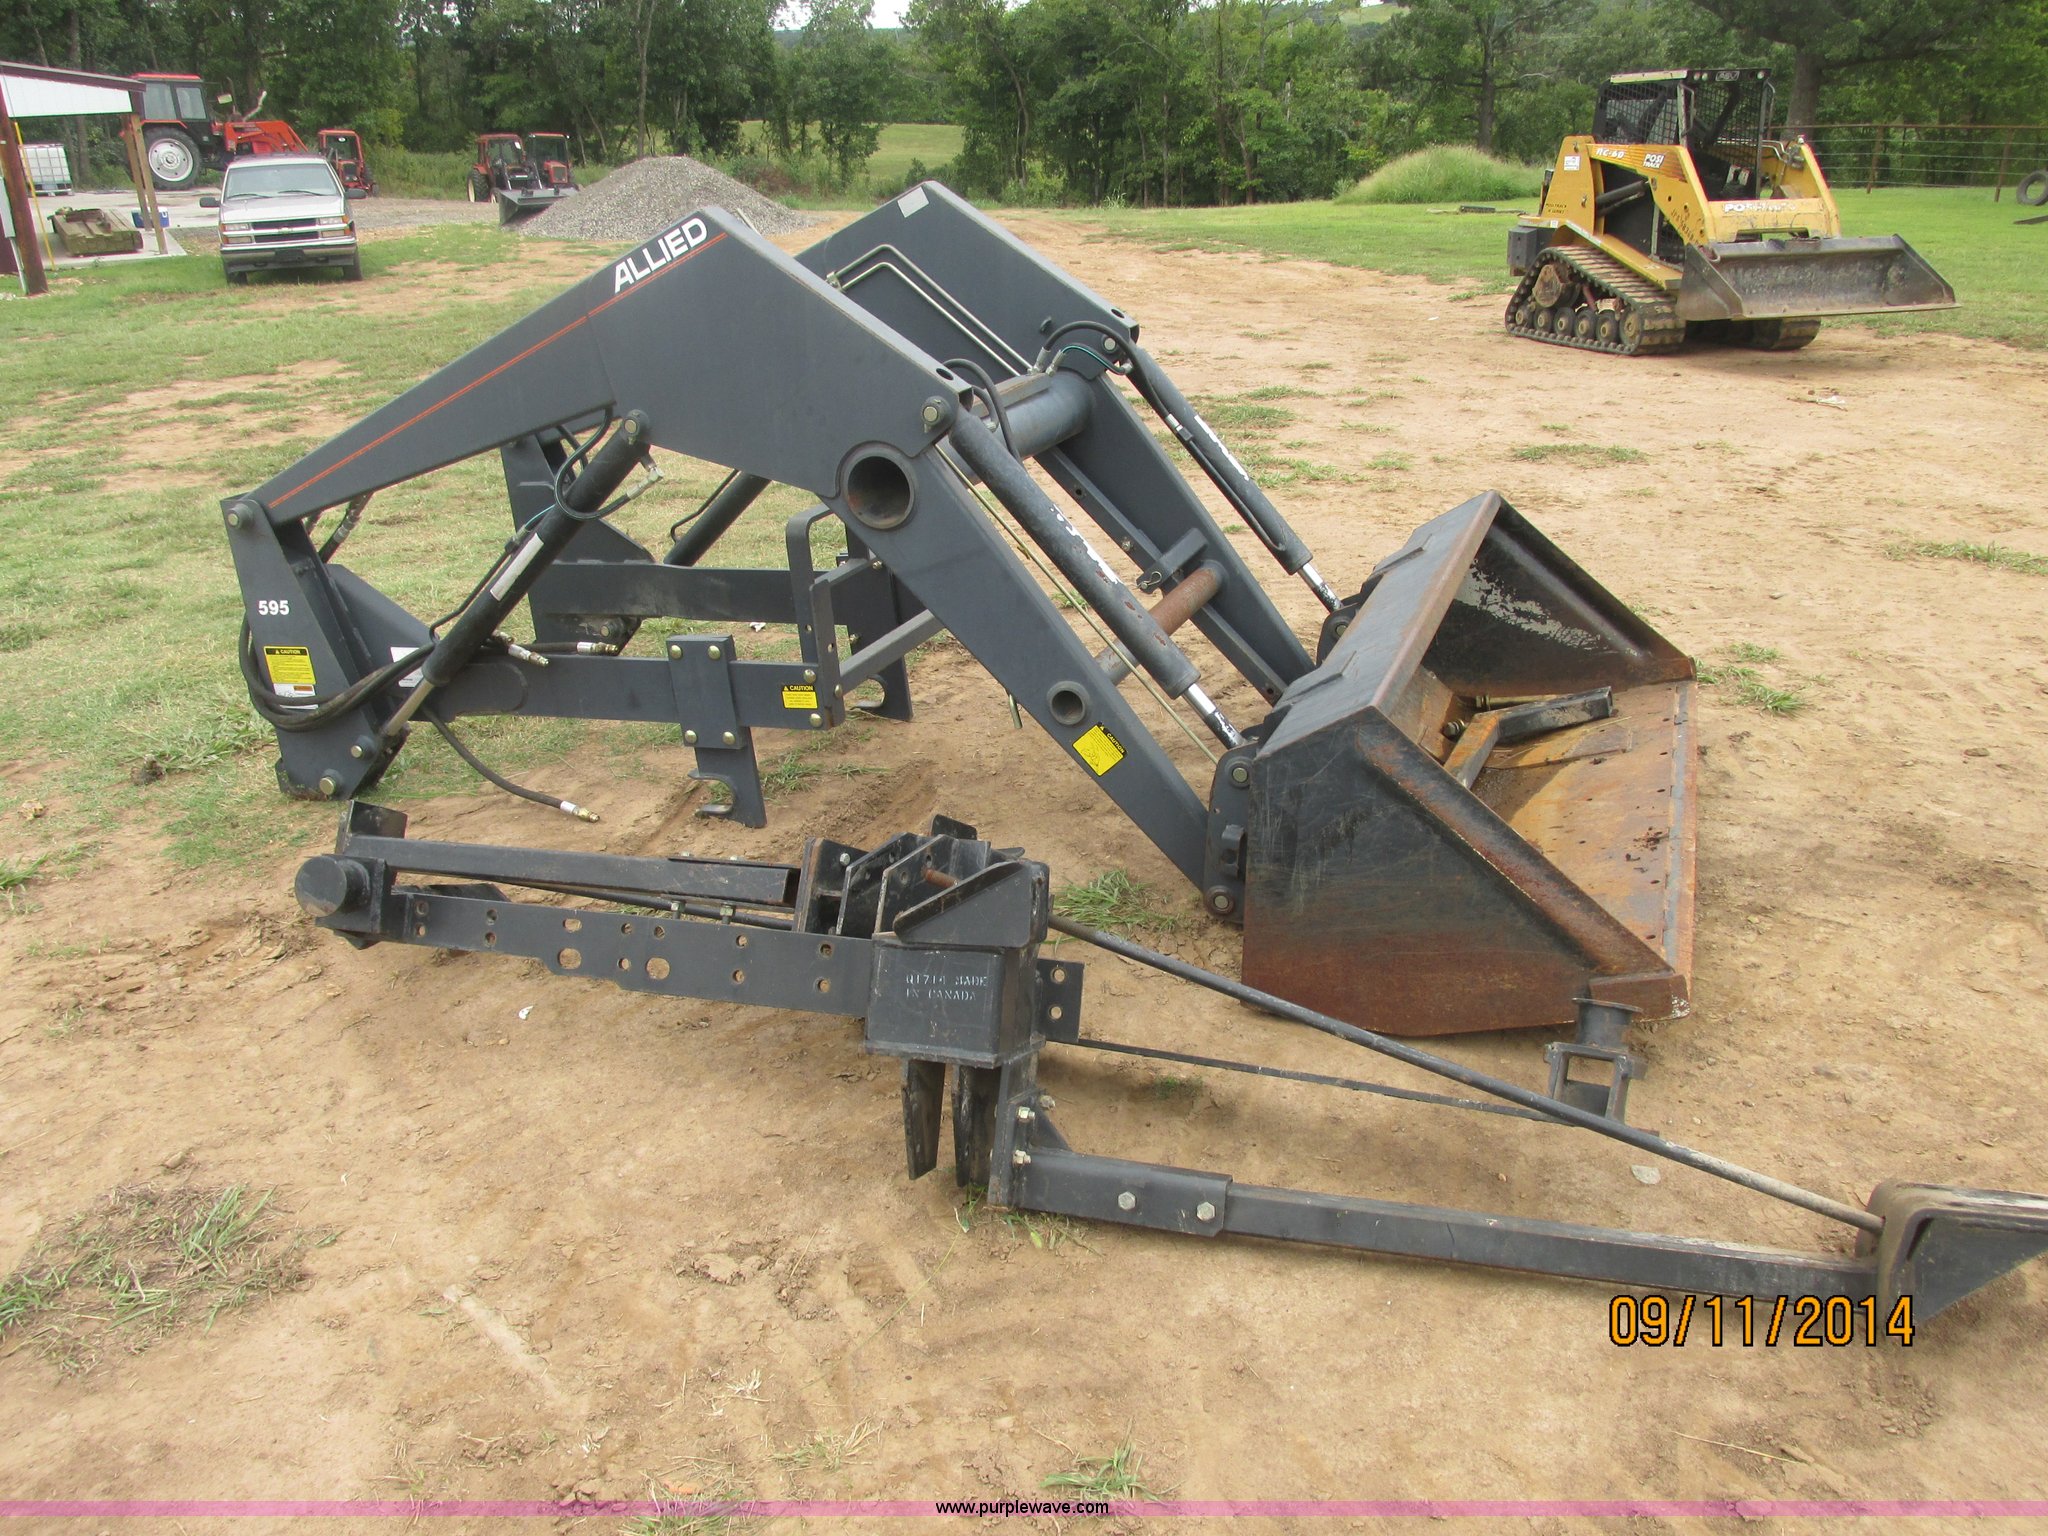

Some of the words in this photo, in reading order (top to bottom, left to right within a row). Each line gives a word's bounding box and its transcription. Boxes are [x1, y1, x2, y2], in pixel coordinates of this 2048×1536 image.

[1645, 153, 1665, 164] POSI
[614, 217, 707, 294] ALLIED
[258, 600, 290, 616] 595
[1106, 732, 1125, 754] CAUTION
[955, 975, 988, 987] MADE
[906, 988, 920, 998] IN
[928, 989, 977, 1001] CANADA
